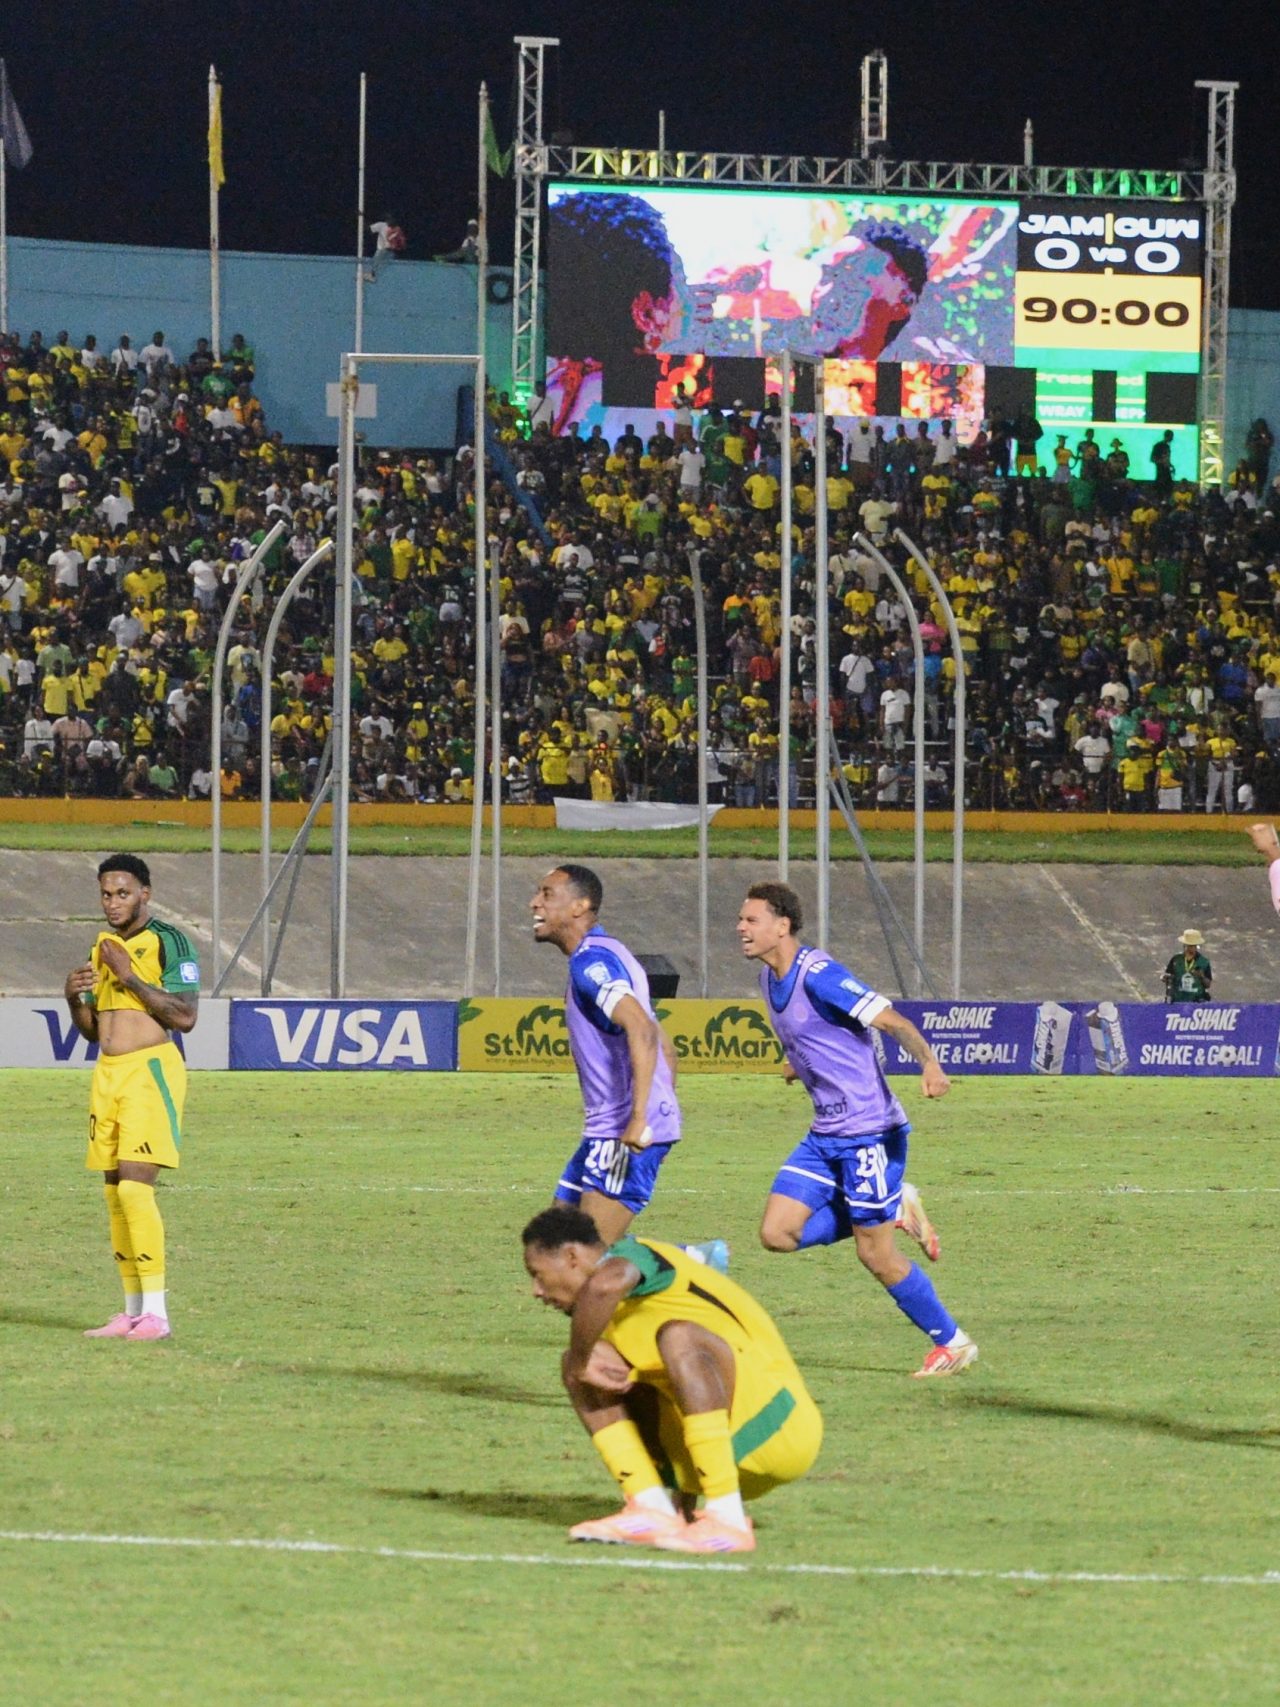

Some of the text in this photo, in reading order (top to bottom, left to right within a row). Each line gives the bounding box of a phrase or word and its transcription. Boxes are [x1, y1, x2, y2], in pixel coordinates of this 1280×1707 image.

[1018, 214, 1199, 239] JAM CUW
[1034, 238, 1180, 273] 0 vs 0
[1023, 297, 1189, 327] 90:00
[1039, 405, 1086, 418] WRAY
[922, 1006, 997, 1030] TruSHAKE
[1165, 1008, 1240, 1031] TruSHAKE
[254, 1007, 428, 1065] VISA
[951, 1047, 962, 1064] &
[1140, 1044, 1194, 1066] SHAKE
[1194, 1048, 1206, 1066] &
[585, 1140, 616, 1171] 20
[856, 1146, 879, 1178] 13
